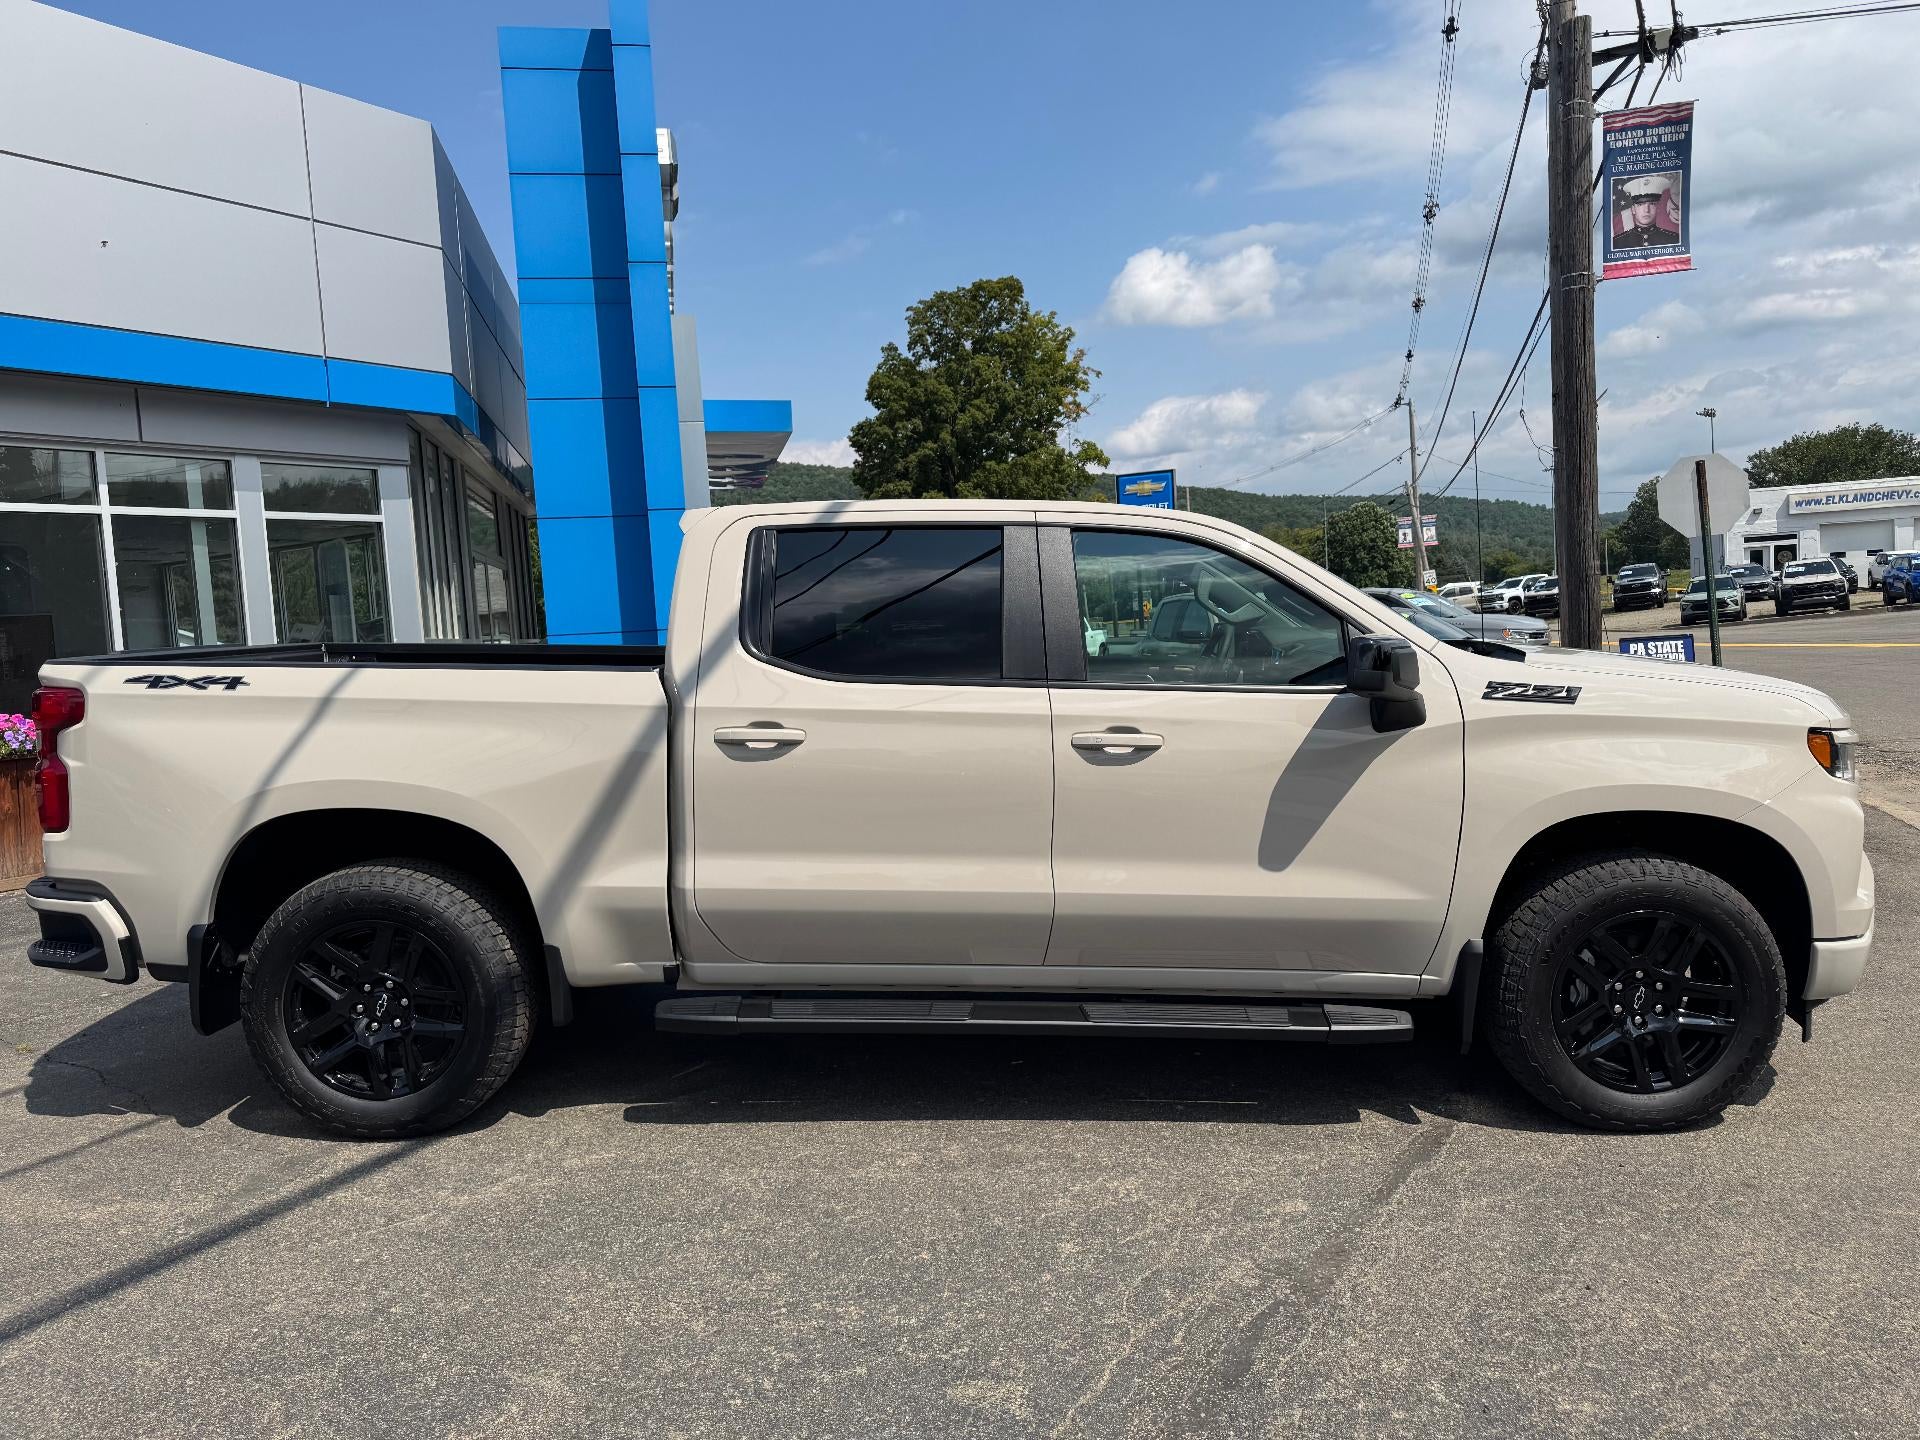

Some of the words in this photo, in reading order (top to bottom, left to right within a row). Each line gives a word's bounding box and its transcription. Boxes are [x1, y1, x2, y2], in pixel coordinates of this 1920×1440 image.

[1606, 129, 1644, 142] ELKLAND
[1646, 124, 1689, 137] BOROUGH
[1609, 135, 1659, 149] HOMETOWN
[1661, 132, 1685, 143] HERO
[1616, 153, 1651, 163] MICHAEL
[1652, 150, 1677, 160] PLANK
[1626, 161, 1656, 171] MARINE
[1656, 159, 1682, 168] CORPS
[1629, 643, 1646, 656] PA
[1647, 640, 1684, 654] STATE
[1481, 680, 1582, 705] Z71
